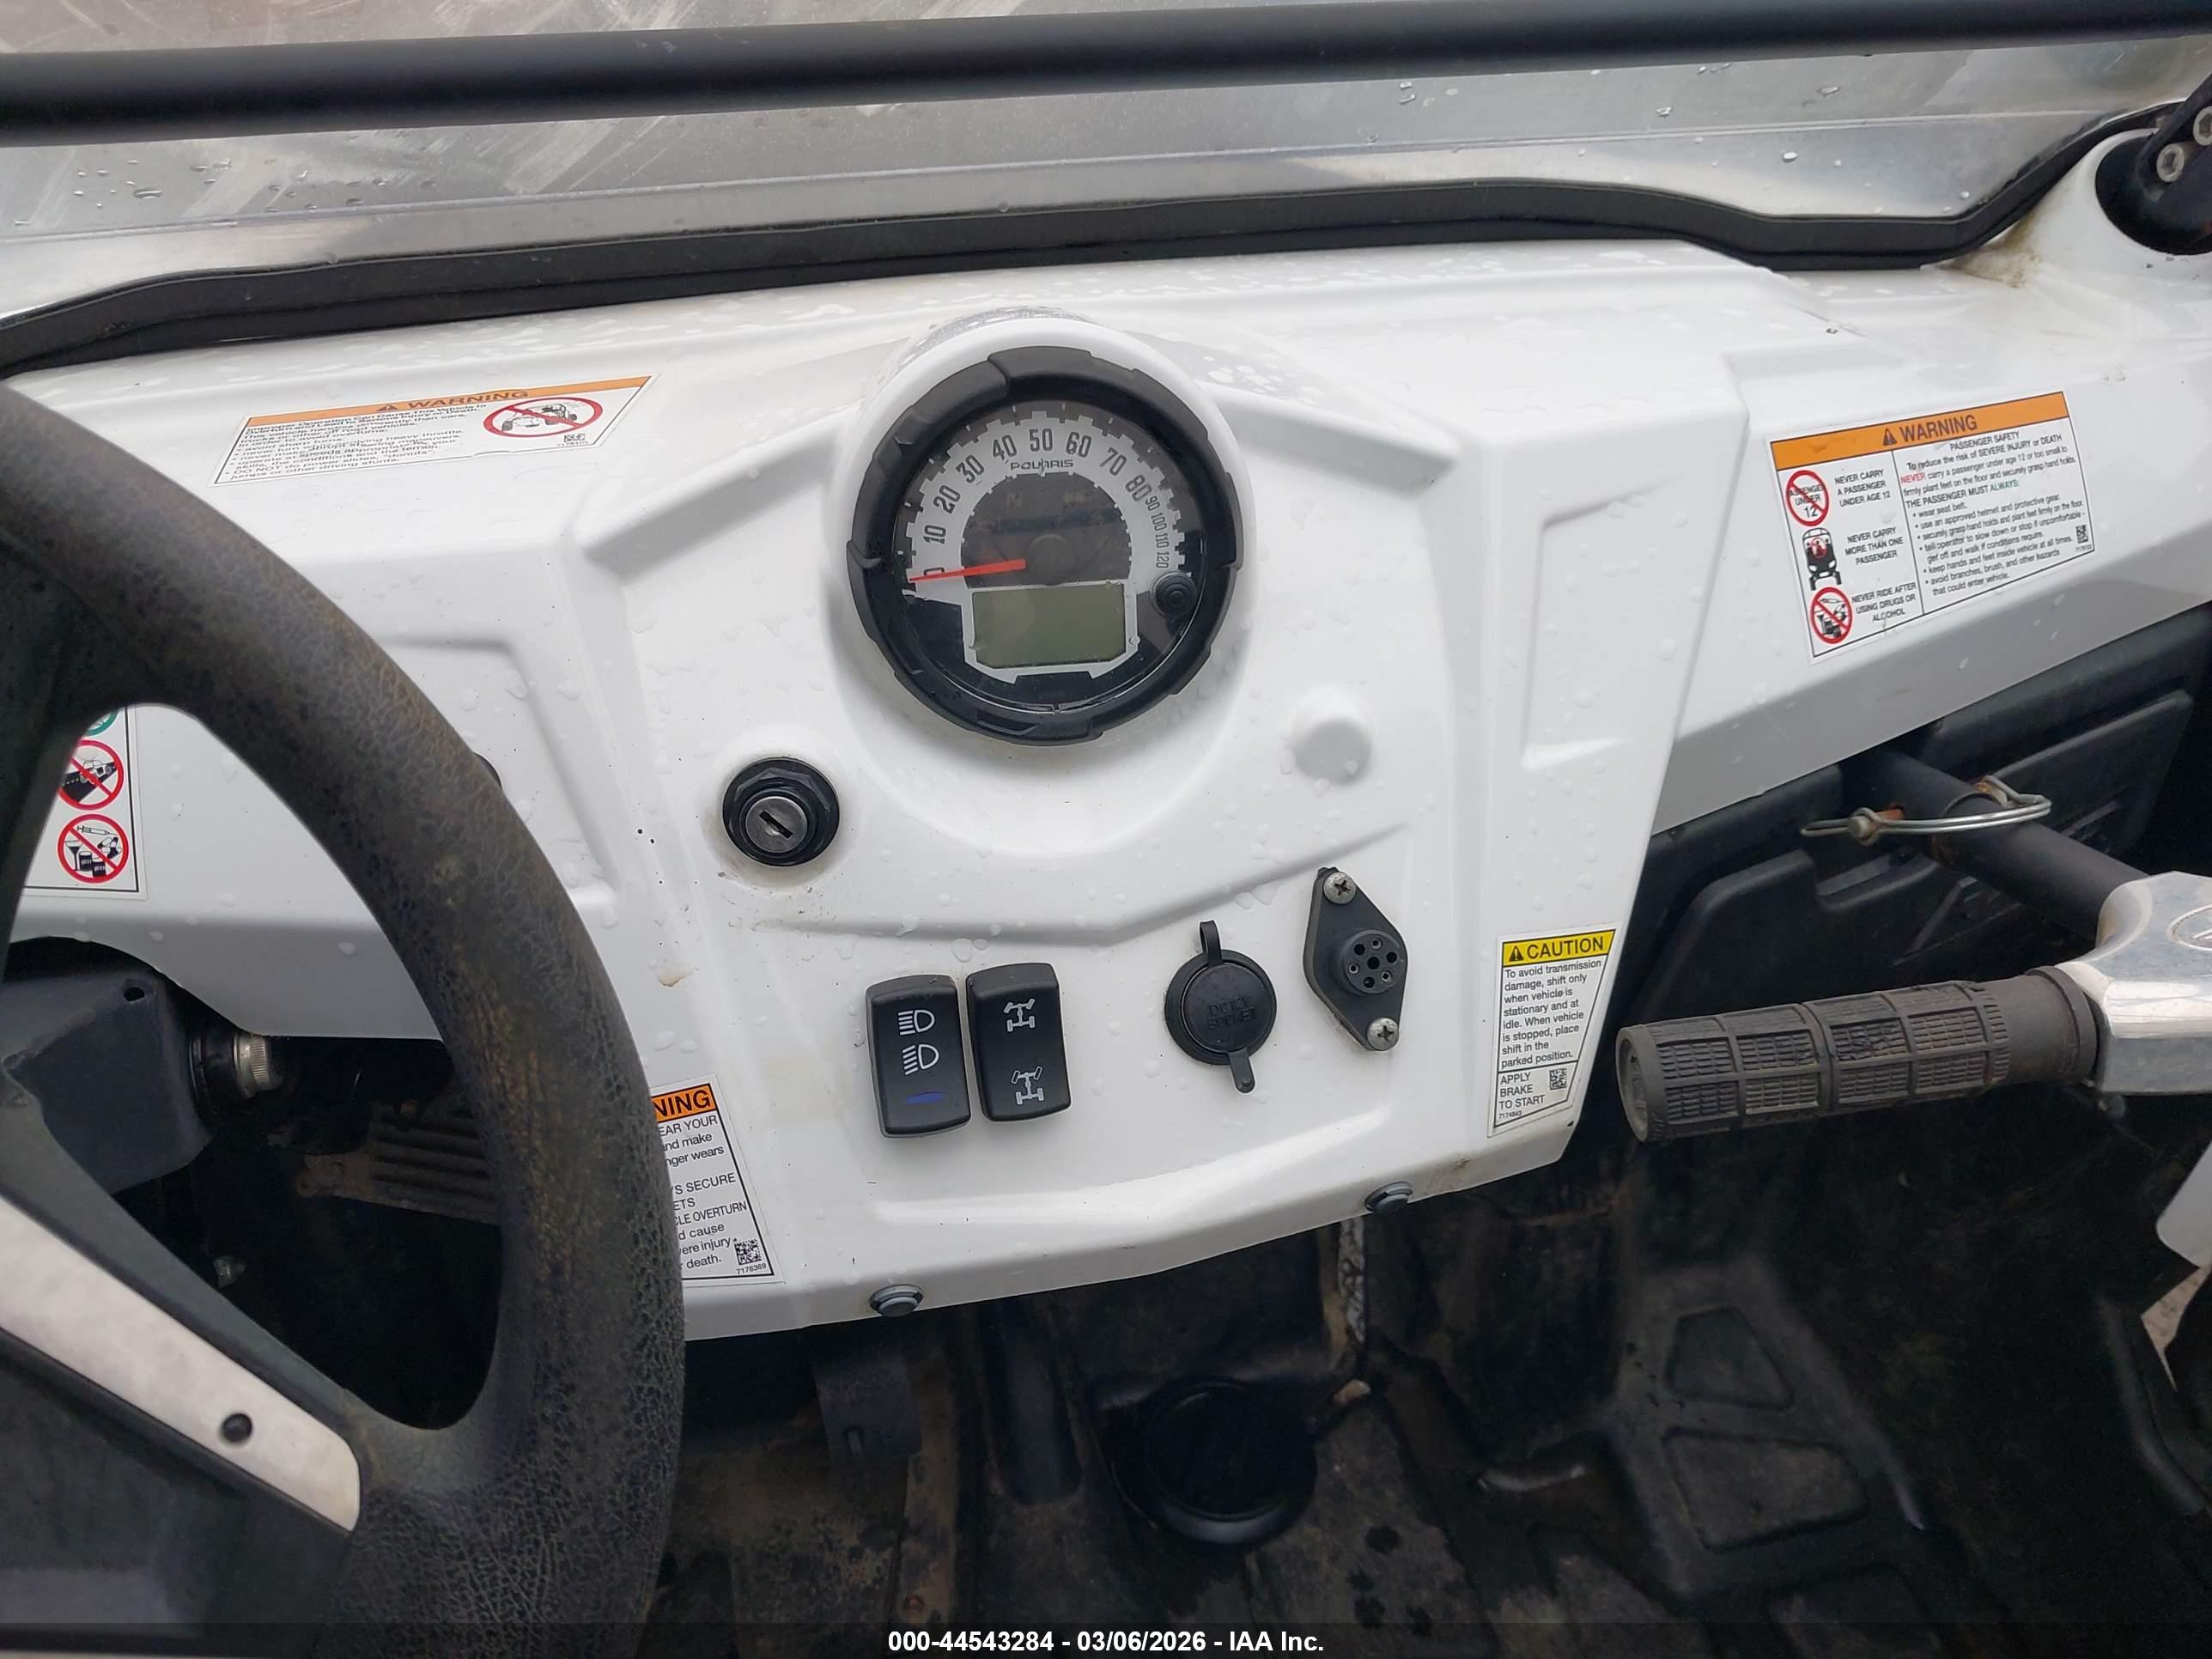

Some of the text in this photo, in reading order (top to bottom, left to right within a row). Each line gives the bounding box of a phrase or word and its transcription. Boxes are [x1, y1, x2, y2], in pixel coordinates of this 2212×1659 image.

[408, 391, 528, 410] WARNING
[1899, 414, 1978, 442] WARNING
[992, 435, 1017, 461] 40
[1030, 428, 1053, 452] 50
[1066, 432, 1092, 458] 60
[1949, 431, 2020, 451] PASSENGER SAFETY
[1906, 461, 1916, 470] To
[1917, 457, 1942, 468] reduce
[1942, 454, 1954, 463] the
[1955, 452, 1968, 460] risk
[1978, 445, 2005, 456] SEVERE
[2006, 440, 2031, 451] INJURY
[2040, 434, 2062, 444] DEATH
[956, 454, 985, 483] 30
[1011, 459, 1074, 471] POLARIS
[1099, 447, 1127, 476] 70
[1900, 472, 1924, 483] NEVER
[1927, 471, 1945, 480] carry
[1951, 462, 1984, 476] passenger
[1985, 457, 2004, 467] under
[2005, 456, 2016, 465] age
[2033, 449, 2044, 458] too
[2045, 446, 2060, 455] small
[1834, 468, 1884, 484] NEVER CARRY
[1126, 476, 1152, 501] 80
[1843, 480, 1886, 494] PASSENGER
[1905, 498, 1921, 508] THE
[1922, 489, 1966, 505] PASSENGER
[1967, 484, 1989, 495] MUST
[933, 485, 962, 514] 20
[1146, 496, 1160, 511] 90
[1838, 495, 1864, 507] UNDER
[1866, 493, 1881, 501] AGE
[1804, 506, 1818, 518] 12
[1152, 513, 1167, 531] 100
[923, 524, 946, 545] 10
[1156, 532, 1170, 548] 110
[1847, 526, 1896, 544] NEVER CARRY
[1844, 537, 1904, 555] MORE THAN ONE
[1156, 552, 1170, 568] 120
[1855, 549, 1897, 565] PASSENGER
[1850, 581, 1916, 603] NEVER RIDE AFTER
[1856, 592, 1915, 614] USING DRUGS OR
[1871, 607, 1905, 620] ALCOHOL
[1527, 936, 1604, 959] CAUTION
[1504, 960, 1601, 979] To avoid transmission
[1504, 974, 1587, 992] damage, shift only
[1504, 988, 1573, 1004] when vehicle is
[1504, 999, 1579, 1018] stationary and at
[1503, 1011, 1584, 1030] idle. When vehicle
[1503, 1024, 1579, 1042] is stopped, place
[1502, 1041, 1549, 1054] shift in the
[1501, 1050, 1573, 1070] parked position.
[1500, 1072, 1530, 1085] APPLY
[1500, 1084, 1534, 1097] BRAKE
[653, 1090, 711, 1116] NING
[1498, 1095, 1545, 1109] TO START
[659, 1115, 718, 1136] EAR YOUR
[682, 1133, 713, 1147] make
[690, 1146, 725, 1160] wears
[686, 1173, 736, 1193] SECURE
[673, 1197, 696, 1211] ETS
[693, 1200, 747, 1223] OVERTURN
[690, 1224, 725, 1238] cause
[701, 1237, 731, 1251] injury
[686, 1255, 721, 1269] death.
